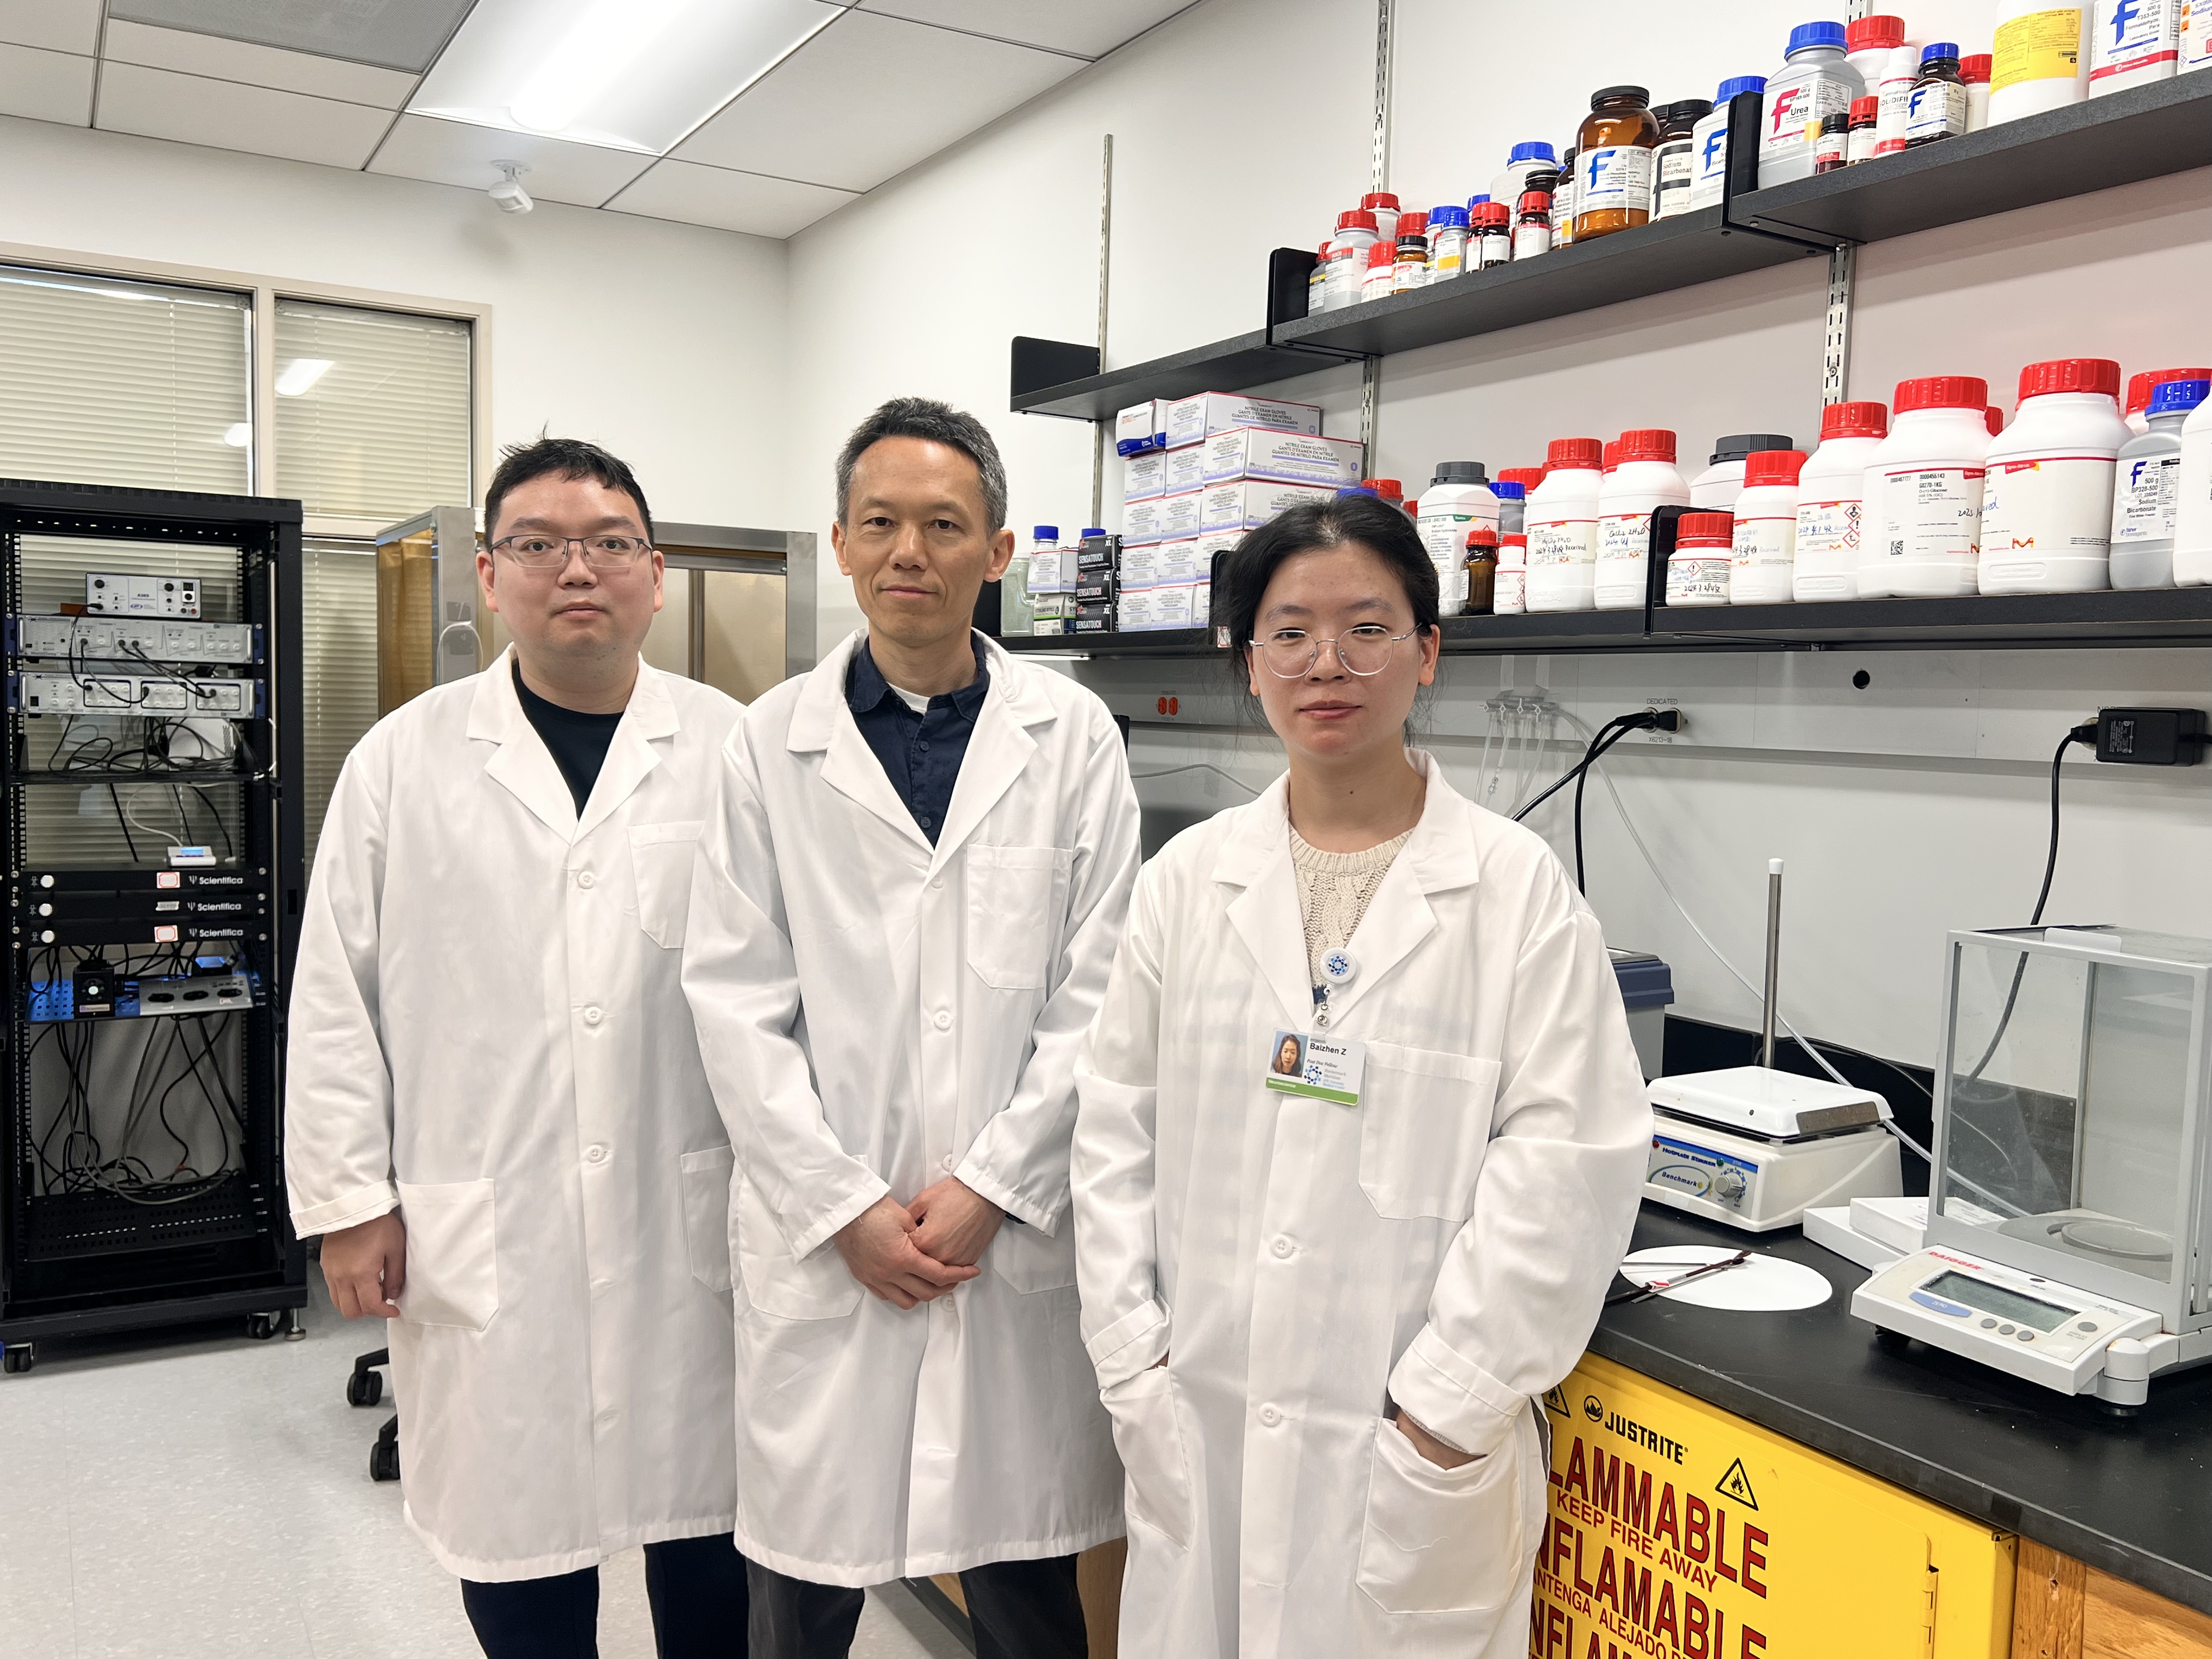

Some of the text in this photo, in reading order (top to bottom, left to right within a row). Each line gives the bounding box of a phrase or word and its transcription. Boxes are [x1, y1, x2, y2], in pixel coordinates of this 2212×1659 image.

[1791, 106, 1809, 116] Urea
[1662, 167, 1692, 177] Bicarbonat
[2131, 485, 2158, 493] BP328-500
[1565, 543, 1587, 551] Received
[1079, 553, 1104, 565] SENSATOUCH
[1076, 587, 1102, 597] SENSATOUCH
[1076, 620, 1102, 630] SENSATOUCH
[199, 876, 244, 885] Scientifica
[197, 902, 242, 911] Scientifica
[199, 928, 244, 938] Scientifica
[1310, 1042, 1339, 1054] Baizhen
[1662, 1171, 1697, 1187] Benchmark
[1928, 1251, 1984, 1270] DAIGGER
[1604, 1411, 1684, 1465] JUSTRITE
[1548, 1423, 1769, 1600] LAMMABLE
[1557, 1489, 1718, 1593] KEEP FIRE AWAY
[1538, 1512, 1767, 1659] NFLAMABLE
[1599, 1608, 1667, 1659] ALEJADO
